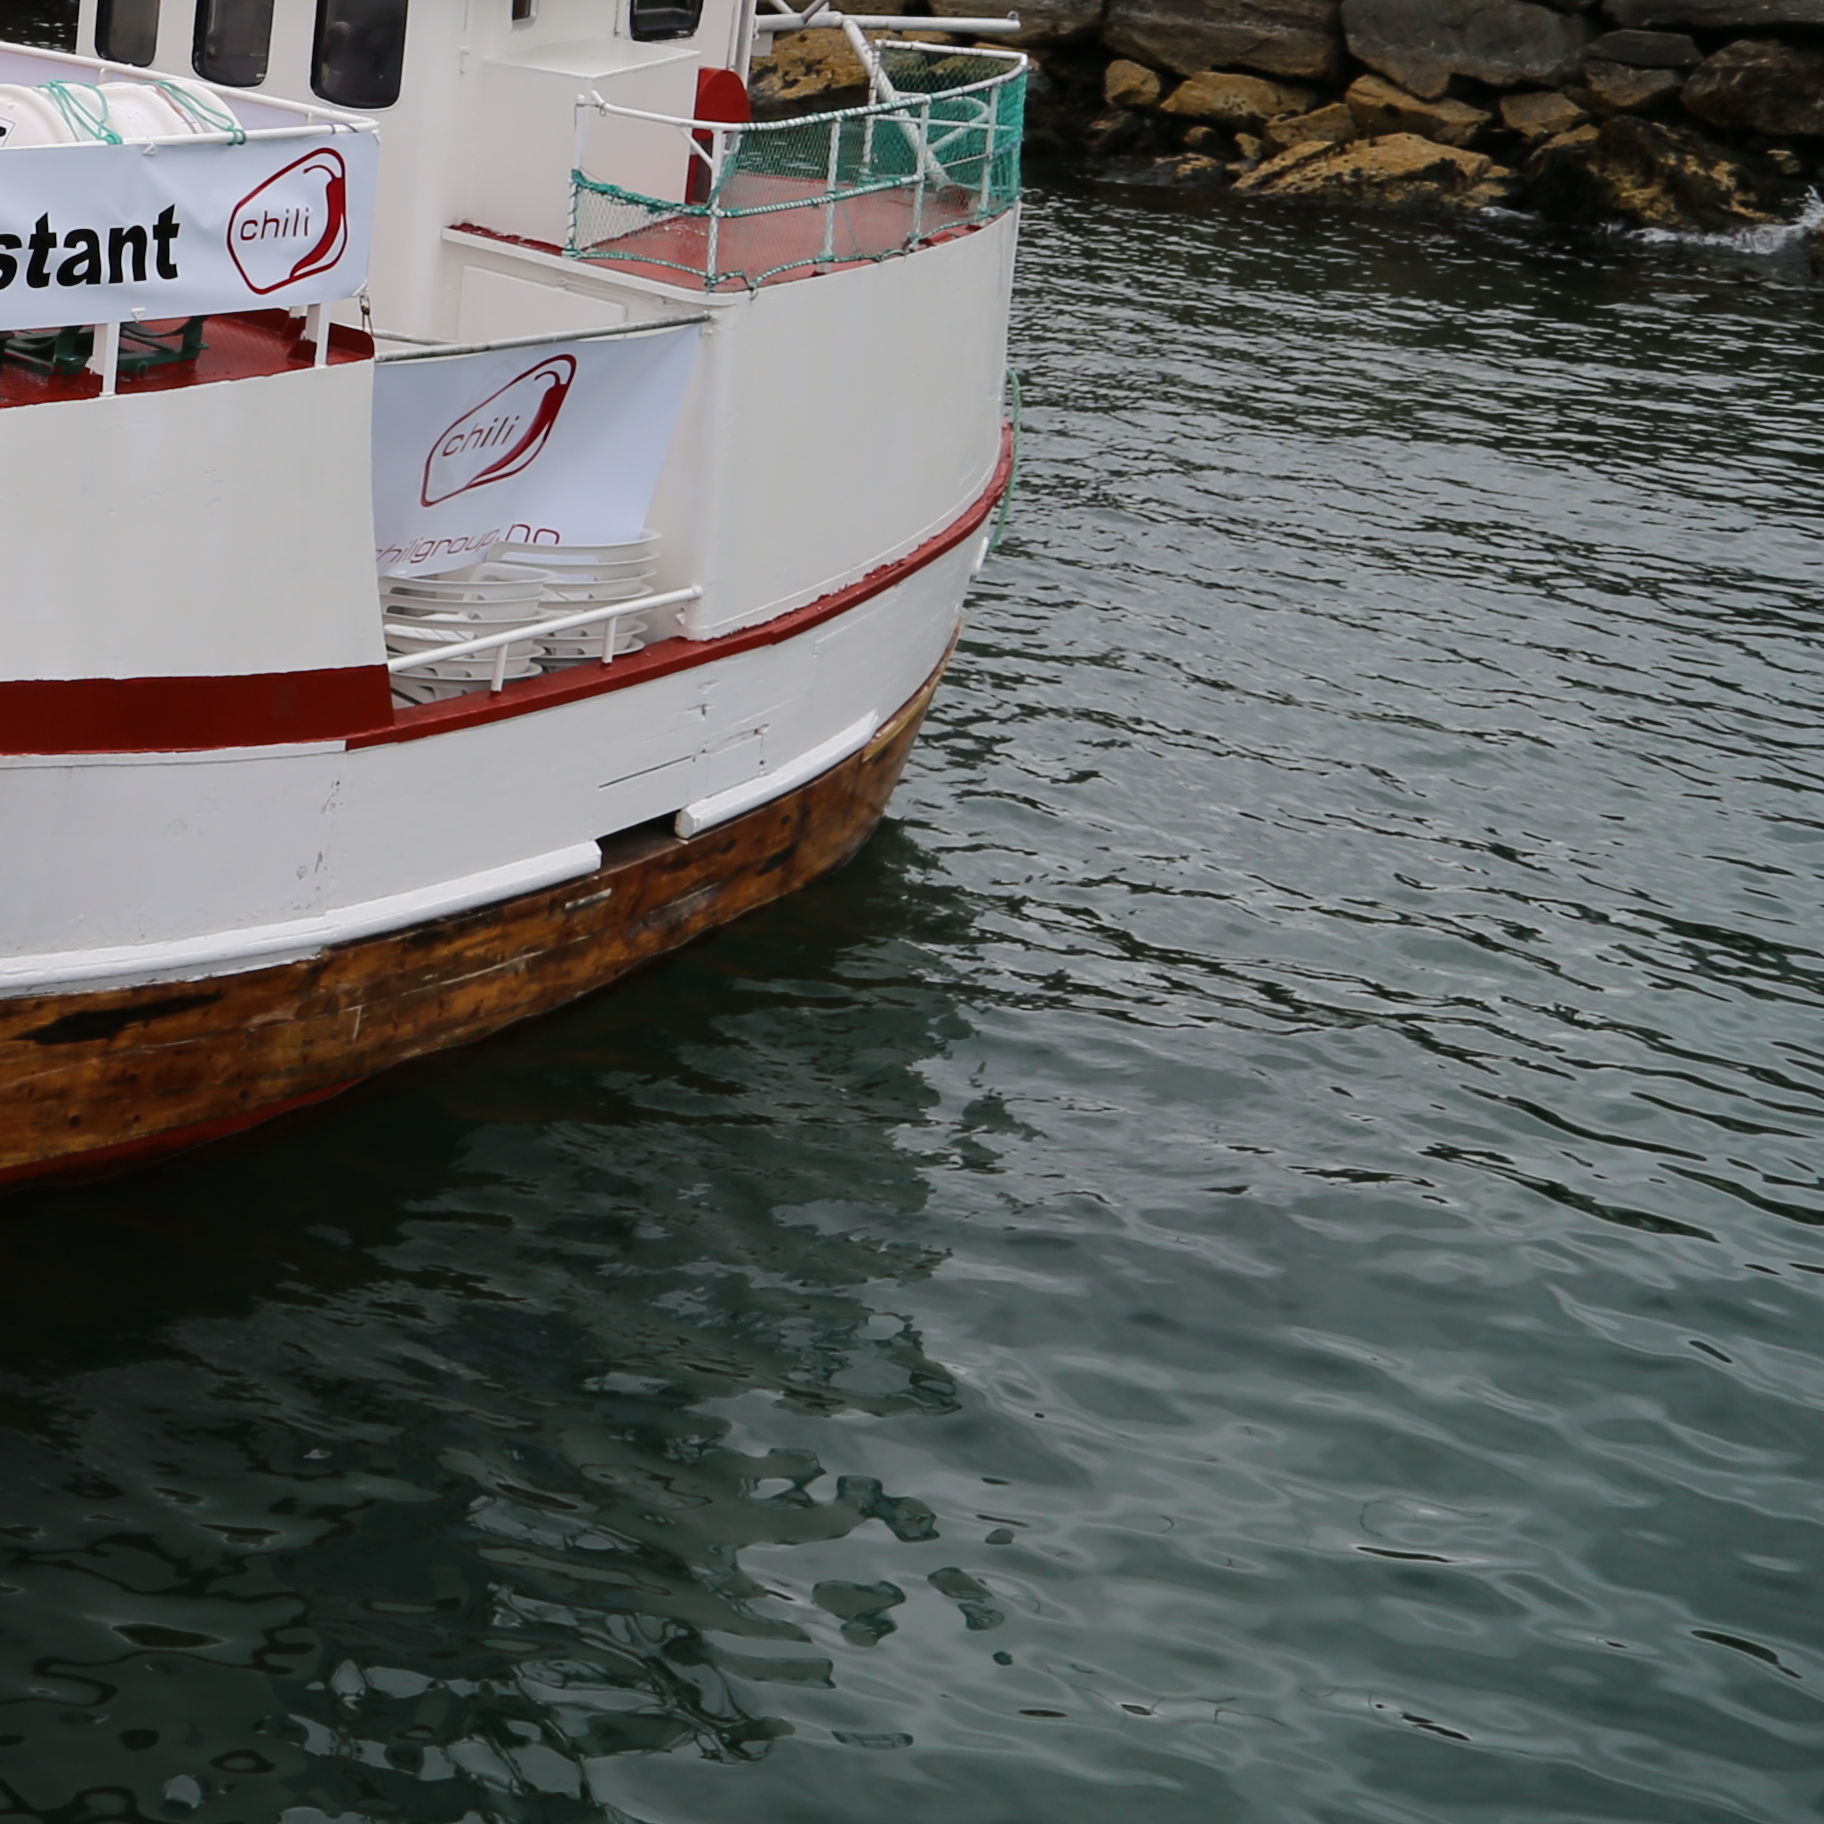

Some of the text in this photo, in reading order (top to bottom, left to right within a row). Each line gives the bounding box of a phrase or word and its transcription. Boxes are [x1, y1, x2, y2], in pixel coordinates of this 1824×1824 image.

[240, 203, 312, 246] chili
[441, 415, 521, 458] chili
[375, 523, 561, 565] hiligroup.no
